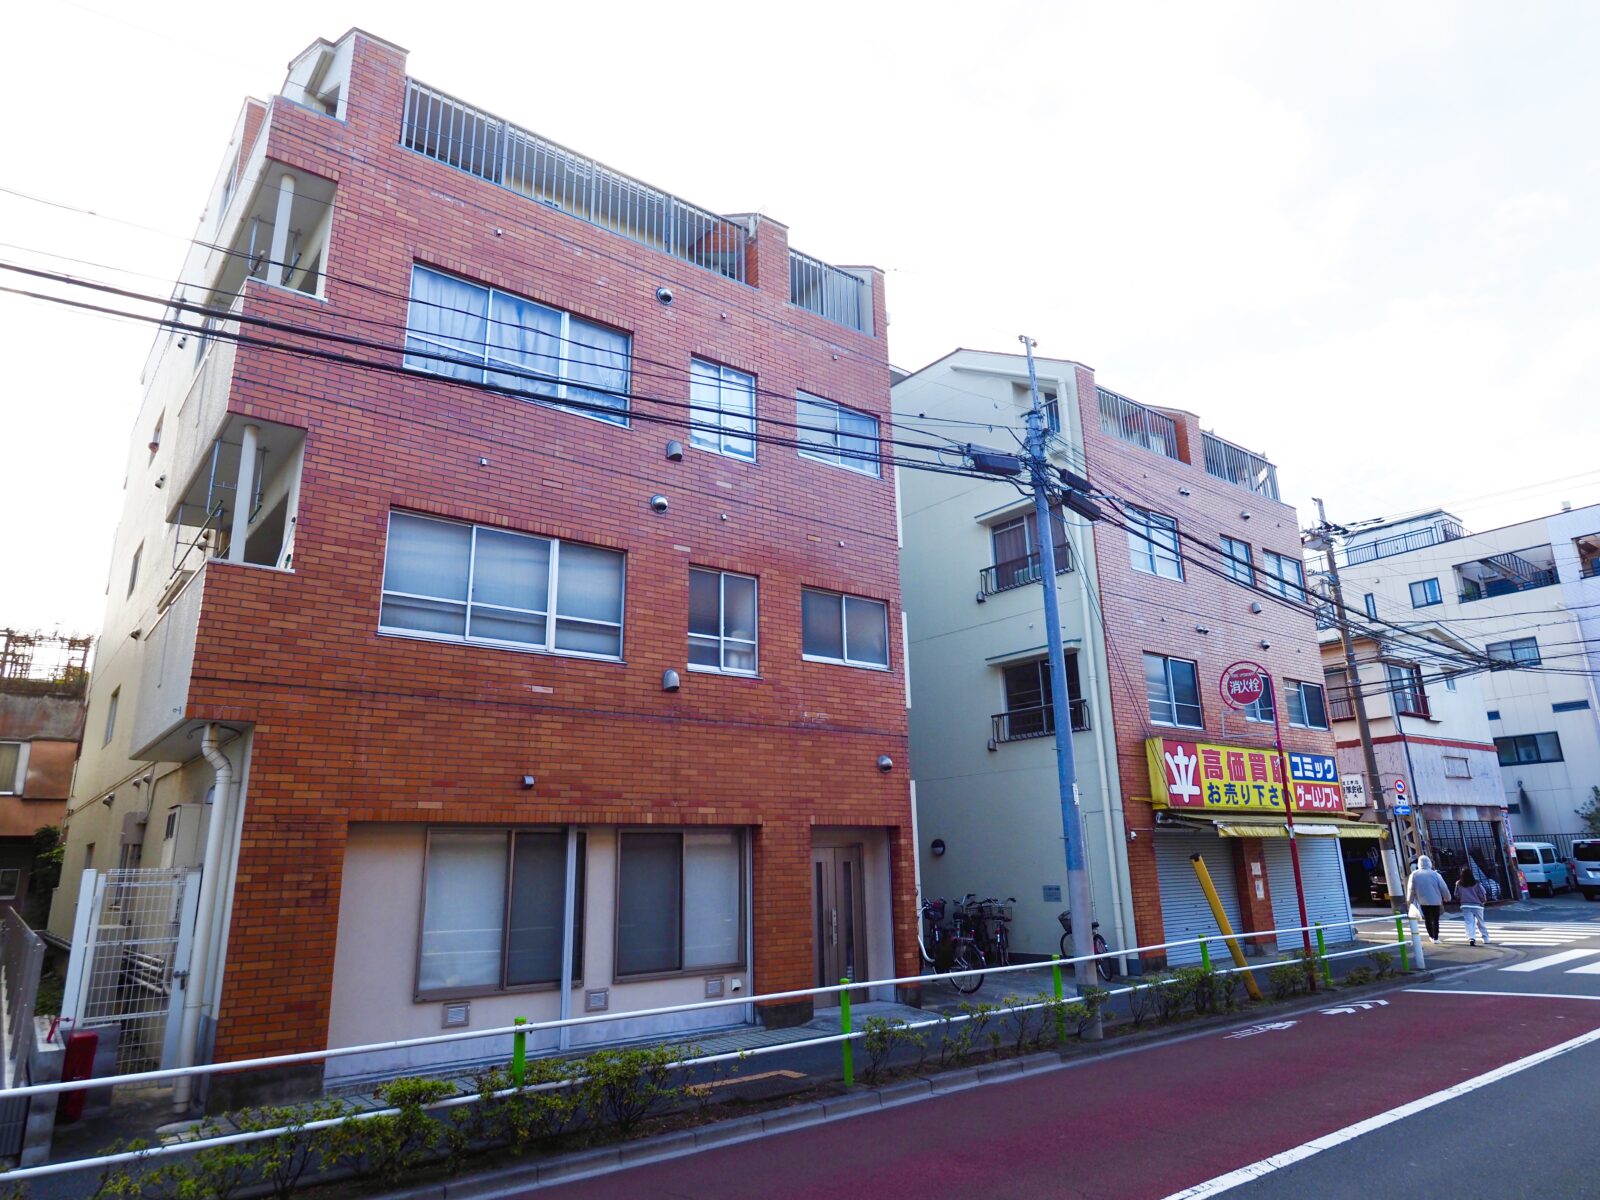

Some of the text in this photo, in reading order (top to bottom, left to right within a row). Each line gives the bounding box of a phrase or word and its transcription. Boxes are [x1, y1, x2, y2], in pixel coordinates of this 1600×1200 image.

[1229, 678, 1261, 695] 消火栓
[1201, 749, 1290, 784] 高価買取
[1291, 756, 1335, 780] コミック
[1207, 781, 1294, 807] お売り下さい
[1296, 784, 1340, 809] ゲームソフト
